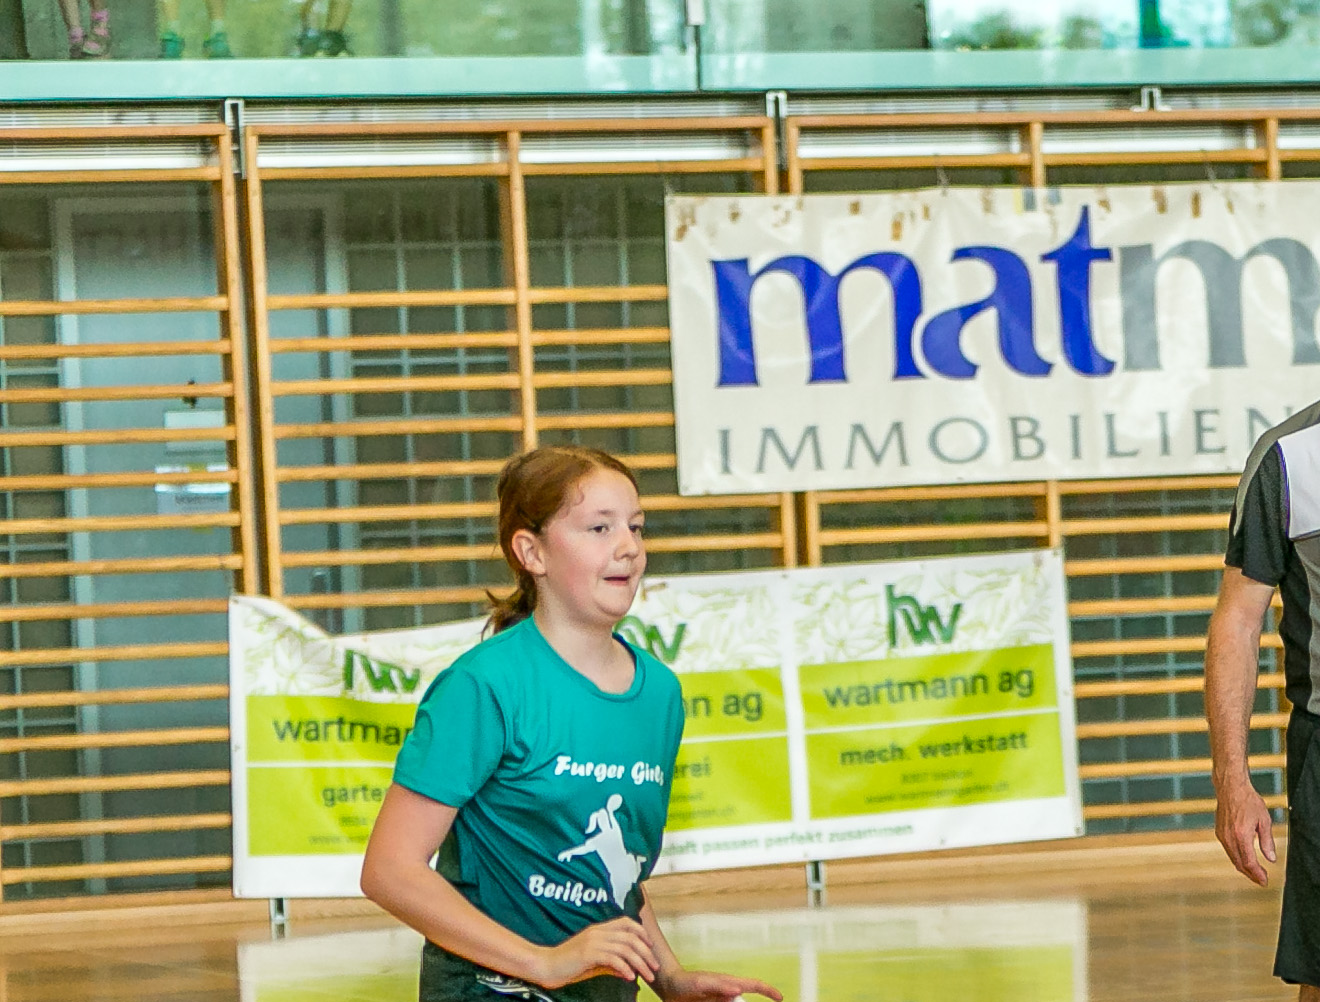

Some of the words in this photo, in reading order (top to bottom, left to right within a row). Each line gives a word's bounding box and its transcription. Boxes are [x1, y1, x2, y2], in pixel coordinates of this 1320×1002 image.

[823, 672, 989, 709] wartmann
[998, 669, 1034, 698] ag
[722, 692, 764, 722] ag
[272, 716, 414, 746] wartma
[919, 731, 1028, 759] werkstatt
[554, 755, 625, 783] Furger
[529, 874, 608, 907] Berikon
